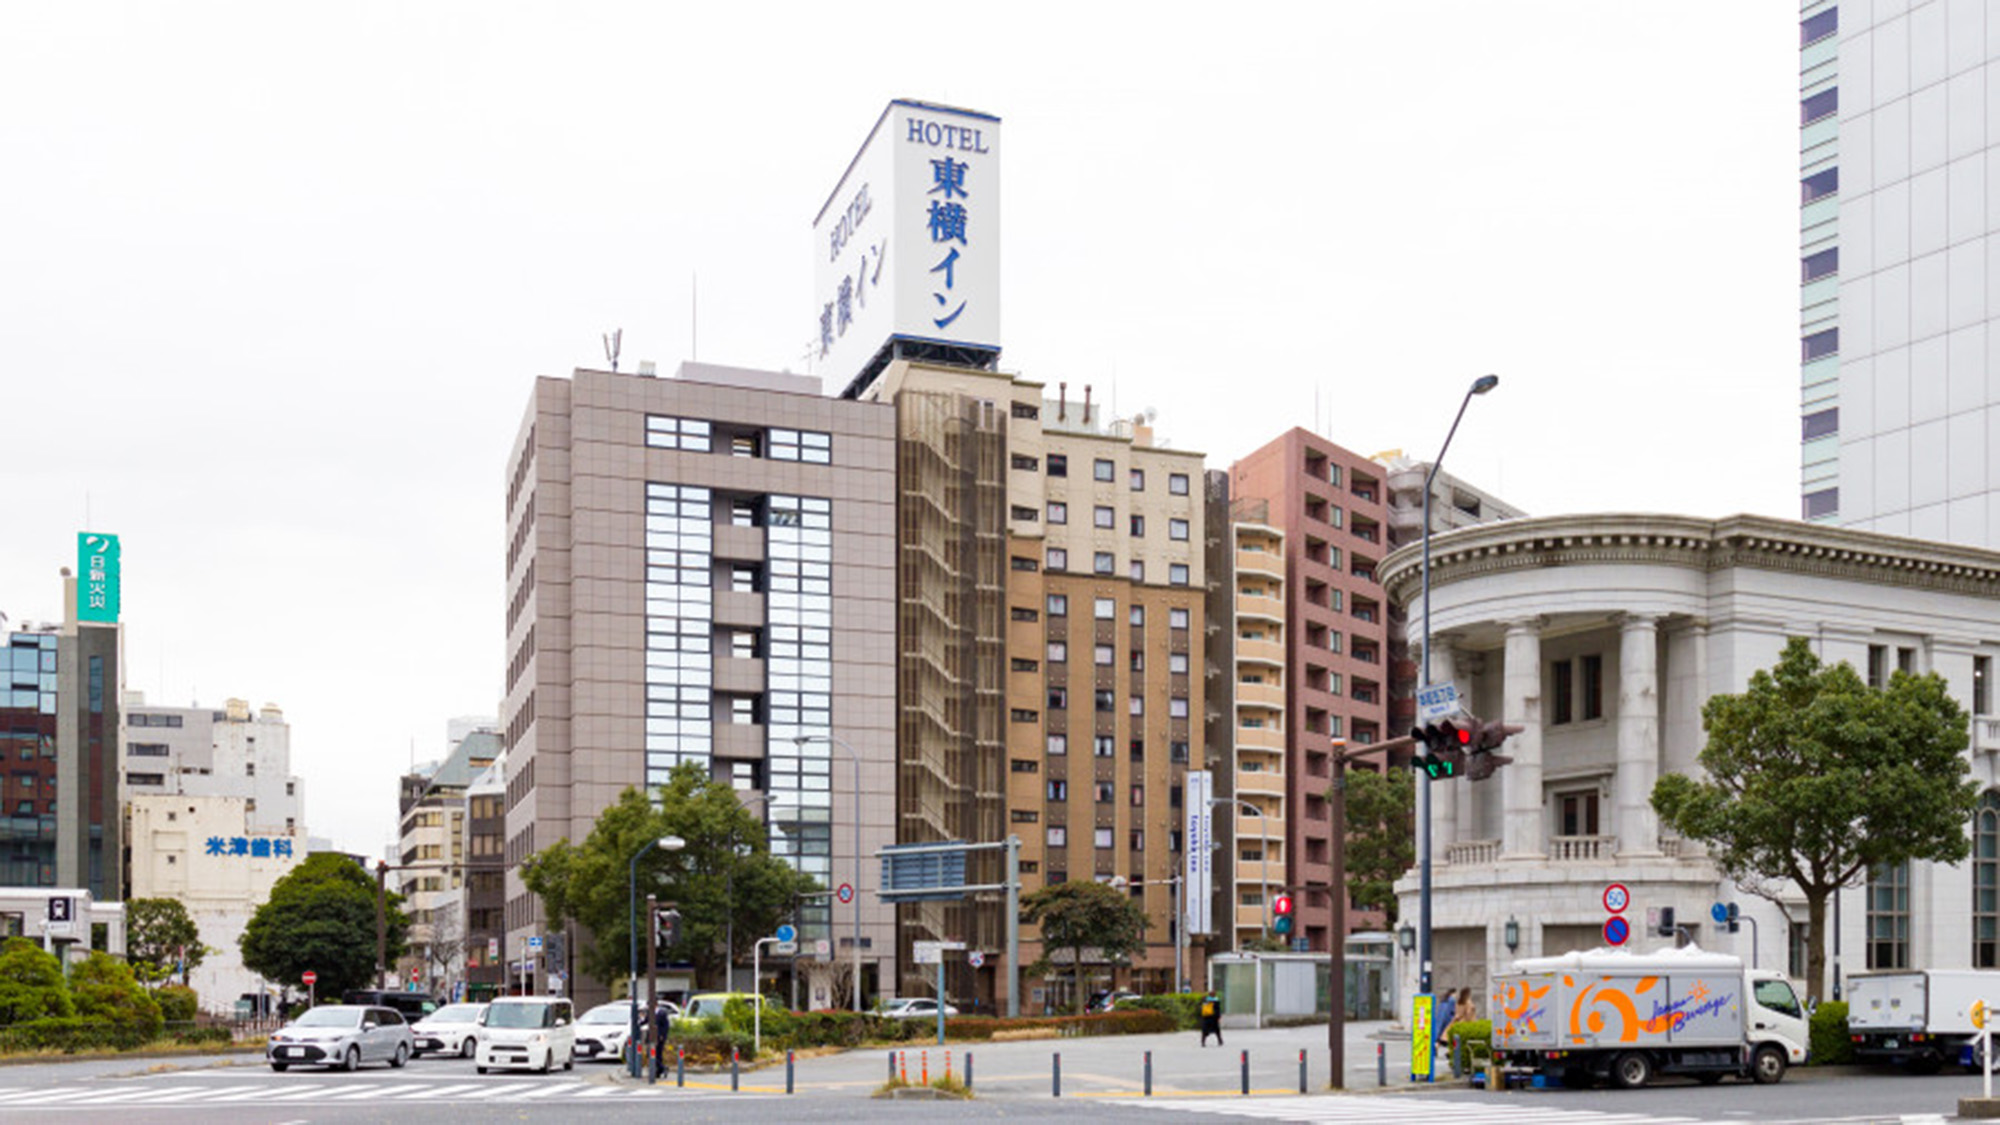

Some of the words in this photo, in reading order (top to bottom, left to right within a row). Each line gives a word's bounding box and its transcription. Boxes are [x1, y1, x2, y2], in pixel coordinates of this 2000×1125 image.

[907, 118, 989, 154] HOTEL
[830, 182, 873, 263] HOTEL
[926, 156, 969, 330] 東横イン
[819, 237, 887, 361] 東横イン
[89, 555, 106, 610] 日新火災
[205, 835, 293, 859] 米津歯科
[1608, 890, 1625, 906] 50
